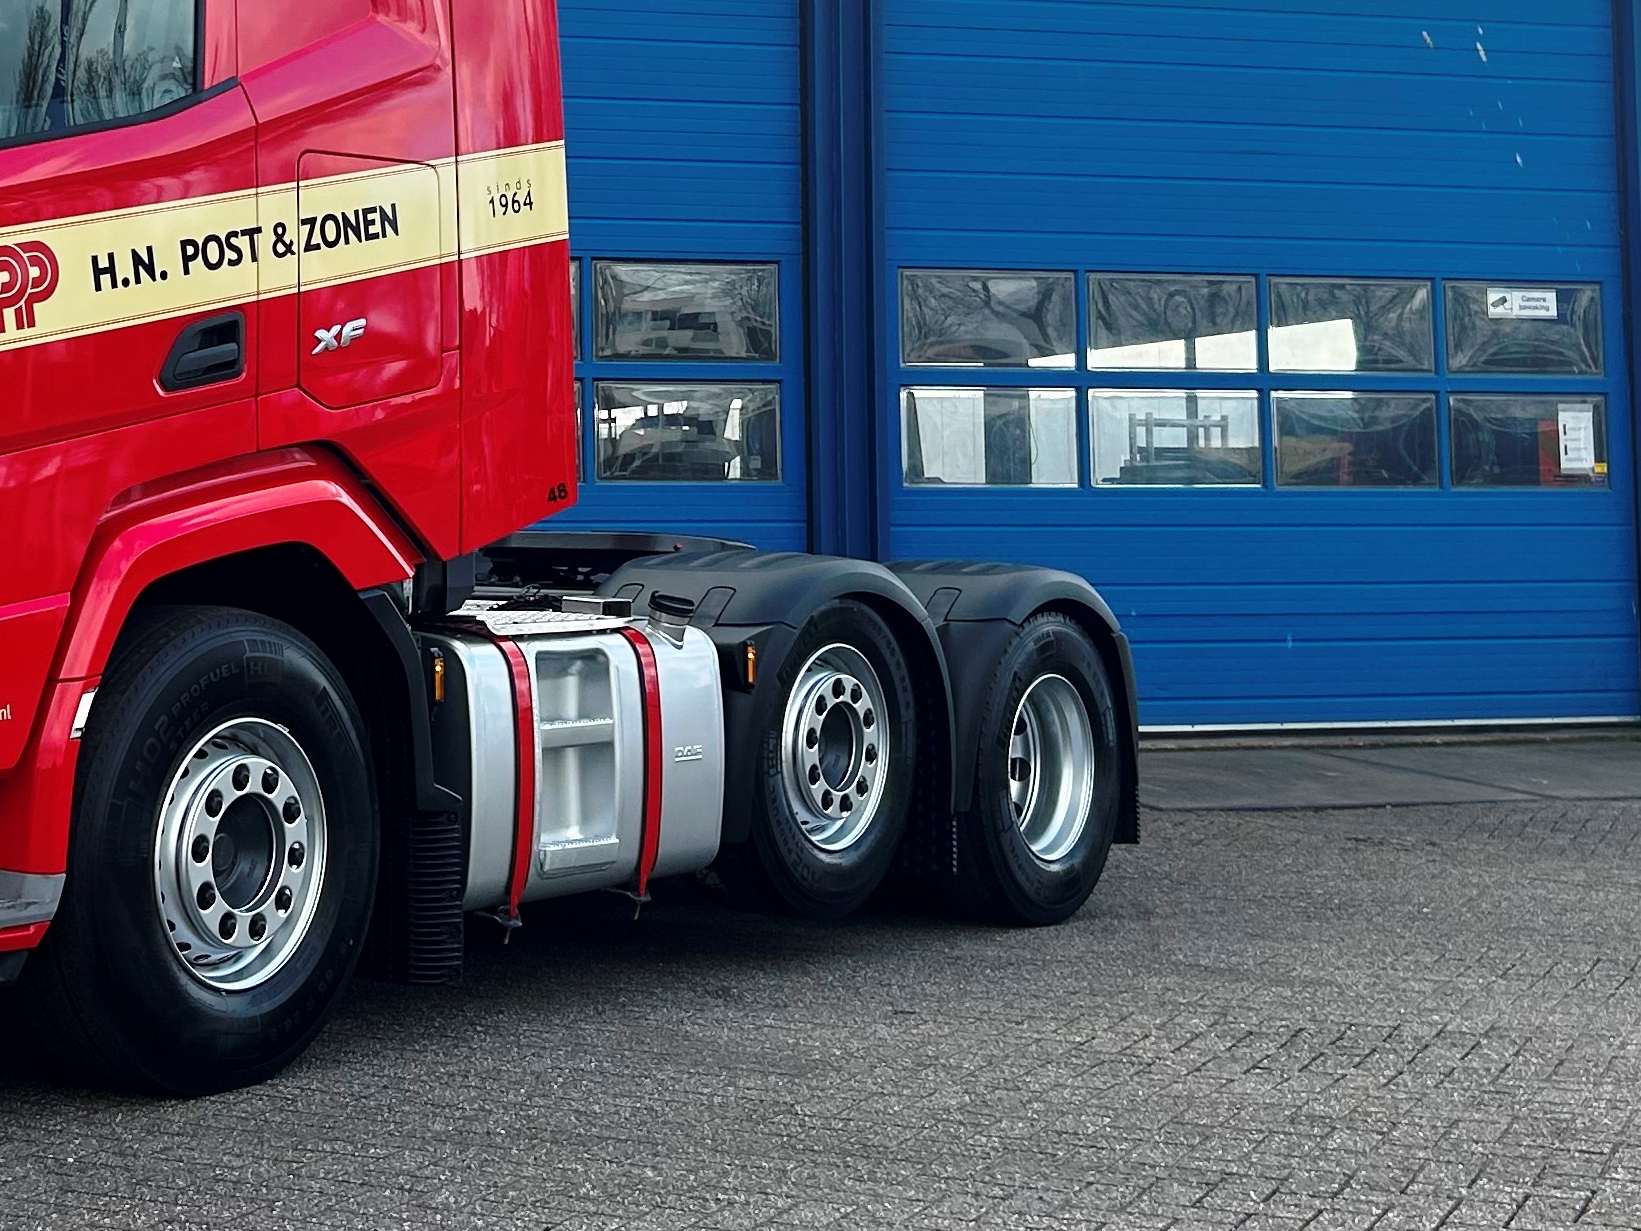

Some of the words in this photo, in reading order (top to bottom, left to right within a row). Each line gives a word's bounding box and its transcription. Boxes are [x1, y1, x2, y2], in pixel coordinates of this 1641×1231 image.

[487, 177, 532, 195] sinds
[489, 189, 534, 218] 1964
[91, 245, 169, 292] H.N.
[180, 227, 262, 276] POST
[272, 222, 296, 259] &
[300, 203, 399, 253] ZONEN
[311, 318, 367, 355] XF
[547, 482, 569, 502] 48
